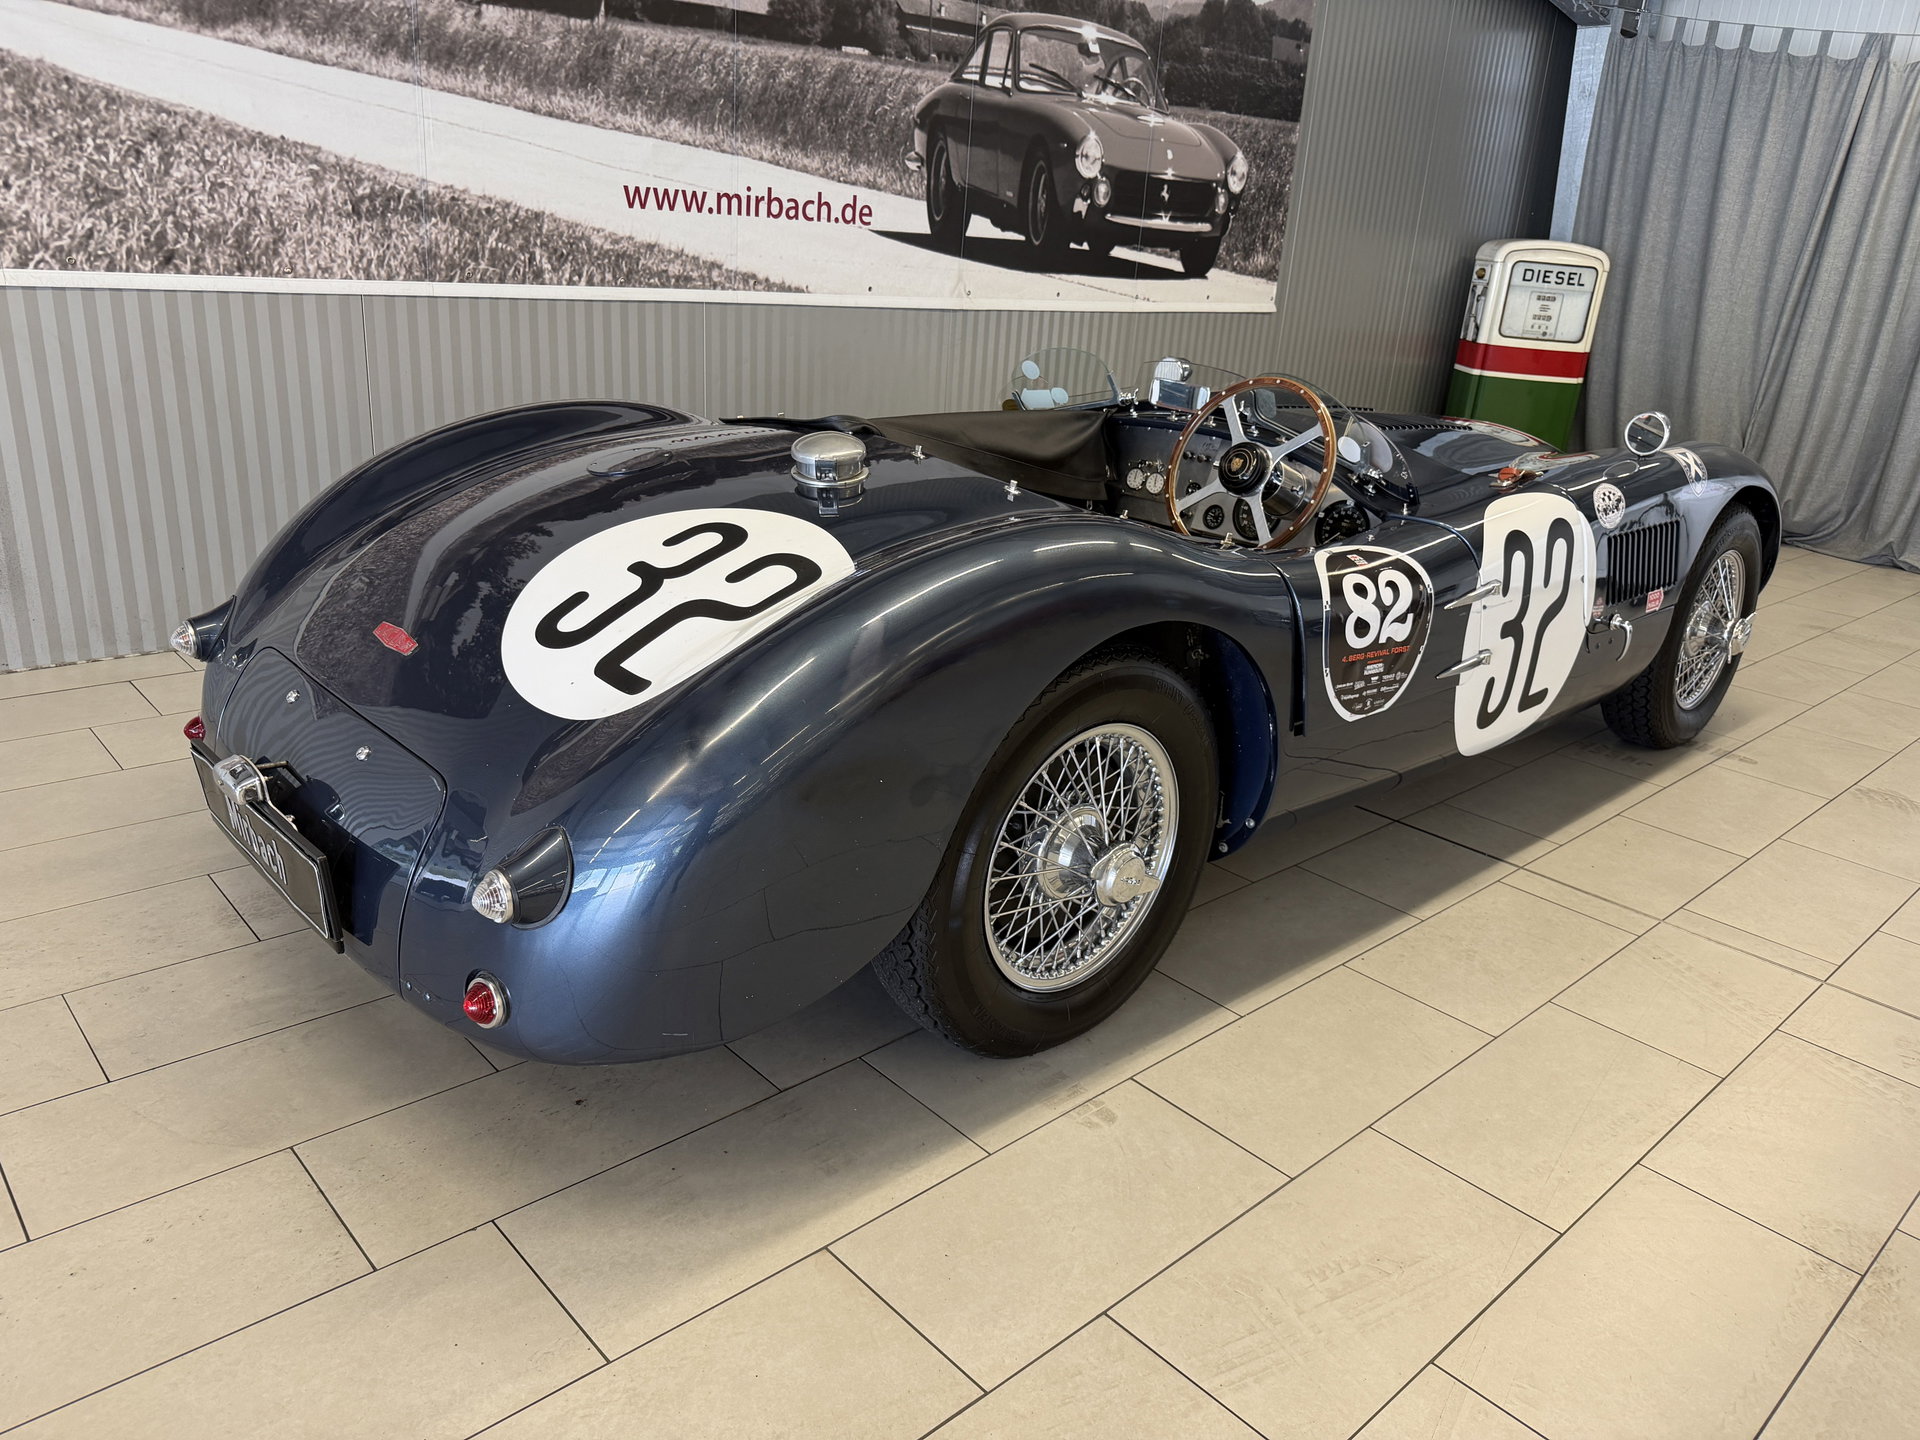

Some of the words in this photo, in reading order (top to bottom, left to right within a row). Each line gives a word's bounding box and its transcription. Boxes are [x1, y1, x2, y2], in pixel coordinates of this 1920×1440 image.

[623, 184, 873, 226] www.mirbach.de
[1521, 268, 1585, 287] DIESEL
[534, 521, 823, 695] 32
[1342, 569, 1414, 649] 82
[1476, 517, 1575, 729] 32
[225, 795, 288, 885] Mirbach
